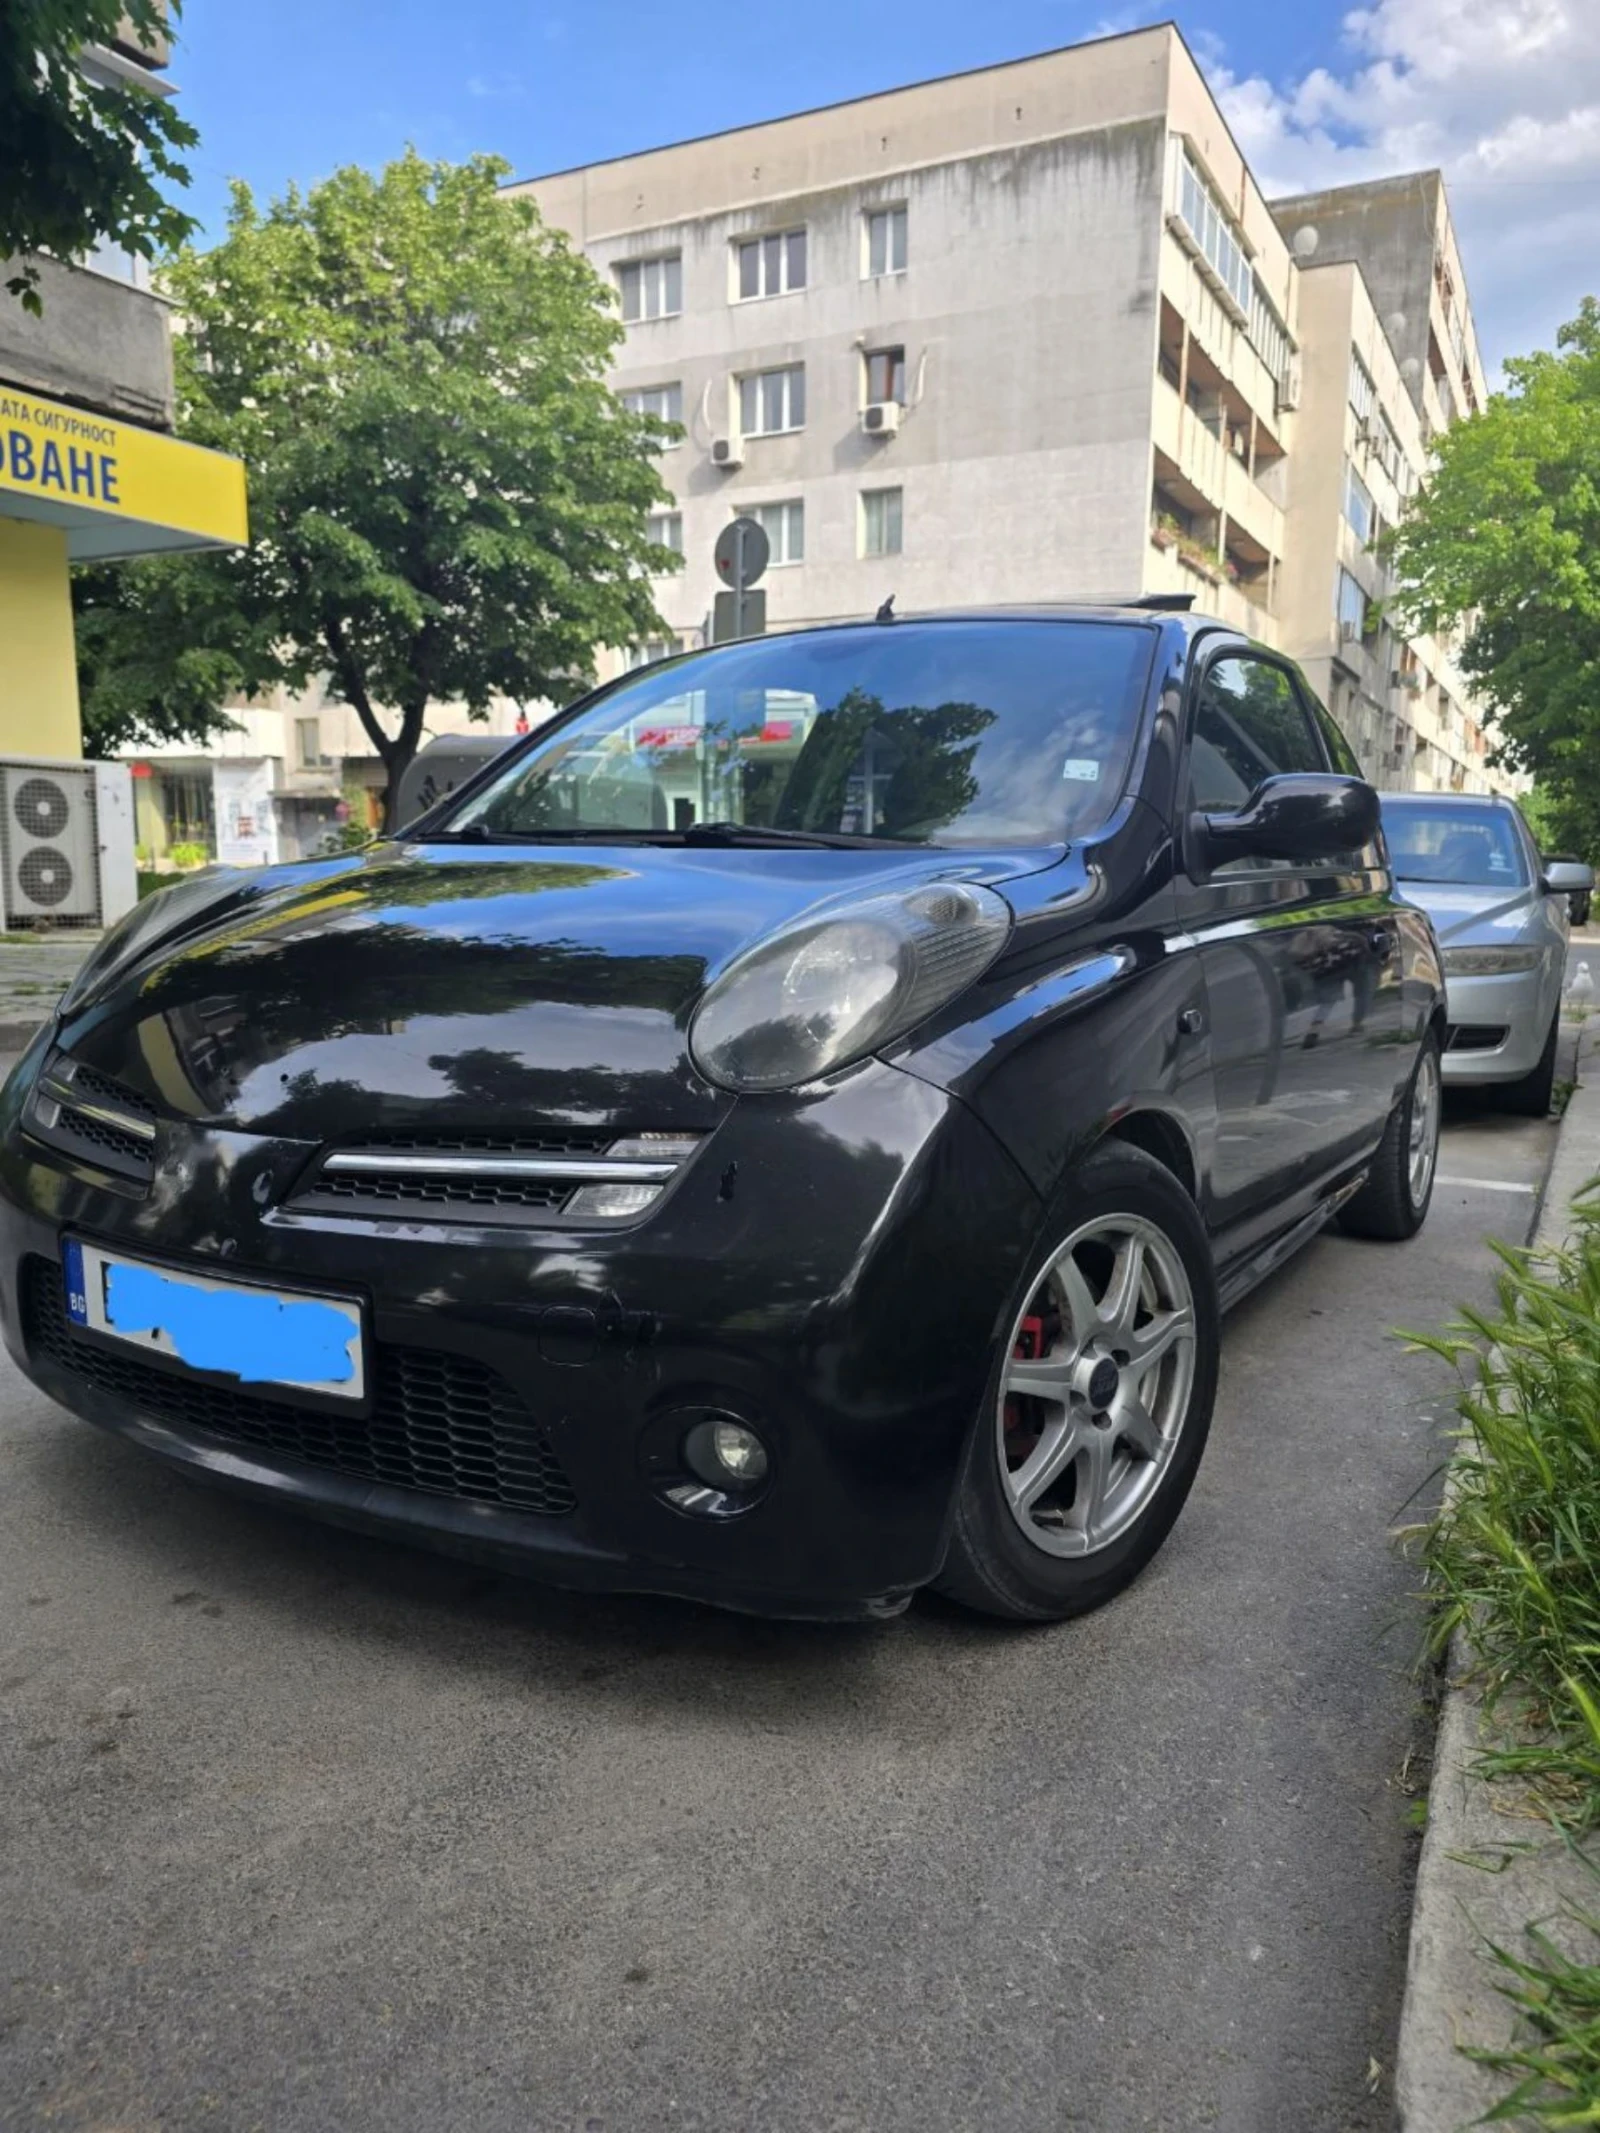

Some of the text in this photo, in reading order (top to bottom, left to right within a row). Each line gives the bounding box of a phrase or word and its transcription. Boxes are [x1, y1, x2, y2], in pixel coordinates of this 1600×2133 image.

[34, 408, 116, 446] СИГУРНОСТ
[0, 430, 120, 504] ВАНЕ
[69, 1292, 86, 1314] BG
